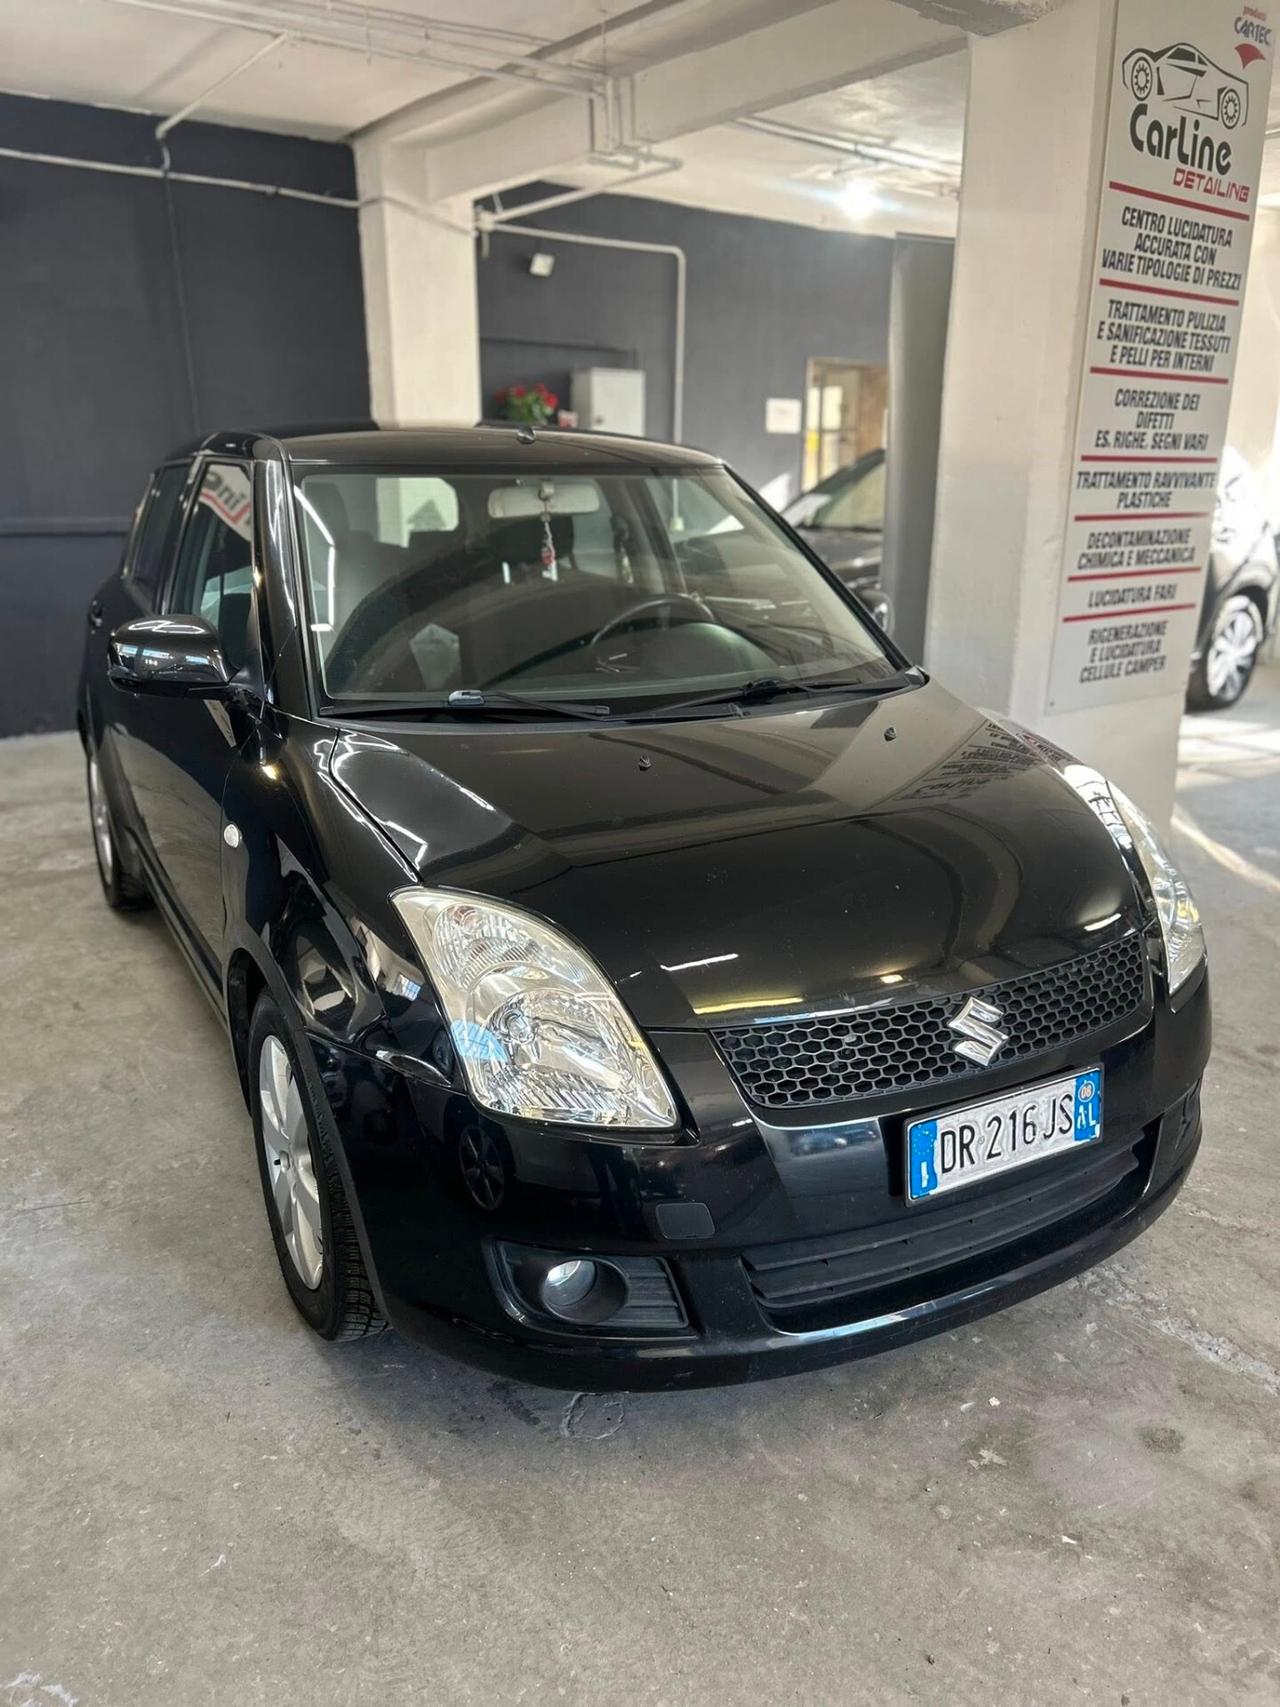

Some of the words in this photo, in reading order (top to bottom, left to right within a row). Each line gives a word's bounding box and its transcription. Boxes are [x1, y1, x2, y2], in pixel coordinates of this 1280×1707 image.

[1234, 16, 1272, 46] CARTEC
[1130, 103, 1231, 175] CarLine
[1173, 168, 1249, 202] DETAILING
[1122, 206, 1166, 234] CENTRO
[1167, 216, 1233, 247] LUCIDATURA
[1134, 233, 1191, 261] ACCURATA
[1194, 245, 1217, 265] CON
[1102, 249, 1135, 273] VARIE
[1136, 256, 1191, 282] TIPOLOGIE
[1193, 267, 1205, 285] DI
[1206, 269, 1241, 290] PREZZI
[1108, 299, 1185, 327] TRATTAMENTO
[1186, 311, 1226, 332] PULIZIA
[1097, 321, 1105, 339] E
[1107, 322, 1188, 349] SANIFICAZIONE
[1189, 333, 1231, 353] TESSUTI
[1110, 345, 1118, 363] E
[1119, 345, 1149, 365] PELLI
[1150, 348, 1171, 368] PER
[1173, 351, 1215, 372] INTERNI
[1115, 388, 1181, 410] CORREZIONE
[1182, 394, 1200, 411] DEI
[1136, 411, 1175, 429] DIFETTI
[1095, 430, 1110, 448] ES.
[1151, 433, 1182, 449] SEGNI
[1184, 433, 1208, 450] VARI
[1077, 472, 1152, 489] TRATTAMENTO
[1153, 472, 1216, 488] RAVVIVANTE
[1117, 492, 1172, 509] PLASTICHE
[1087, 529, 1191, 549] DECONTAMINAZIONE
[1078, 550, 1124, 569] CHIMICA
[1126, 549, 1133, 566] E
[1135, 546, 1195, 566] MECCANICA
[1088, 585, 1152, 608] LUCIDATURA
[1154, 583, 1177, 600] FARI
[1088, 622, 1168, 644] RIGENERAZIONE
[1090, 647, 1098, 663] E
[1099, 639, 1161, 662] LUCIDATURA
[1079, 662, 1123, 683] CELLULE
[1125, 655, 1166, 676] CAMPER
